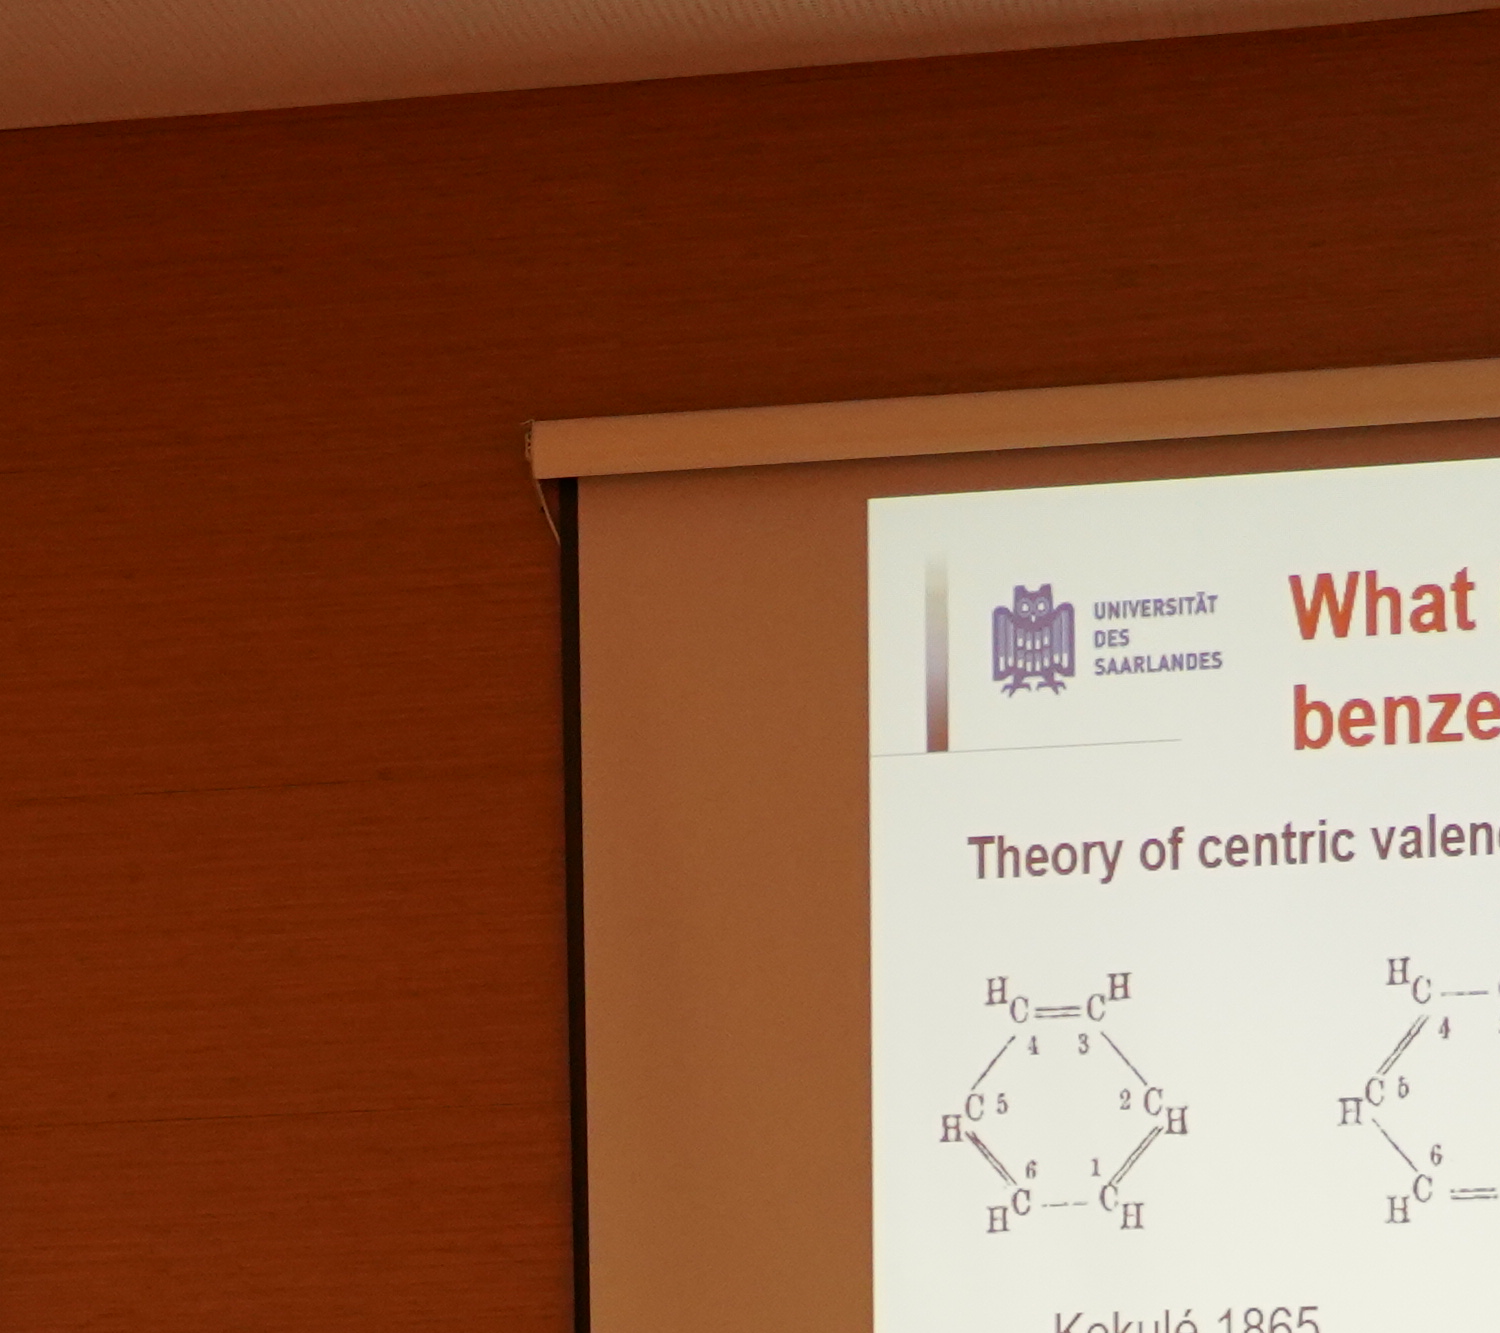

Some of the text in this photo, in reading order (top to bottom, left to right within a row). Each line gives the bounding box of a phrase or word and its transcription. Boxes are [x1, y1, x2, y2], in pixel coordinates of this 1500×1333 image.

[1093, 591, 1219, 621] UNIVERSITÄT
[1287, 566, 1477, 641] What
[1093, 628, 1131, 649] DES
[1094, 650, 1224, 677] SAARLANDES
[967, 834, 1124, 885] Theory
[1139, 825, 1186, 872] of
[1198, 818, 1356, 869] centric
